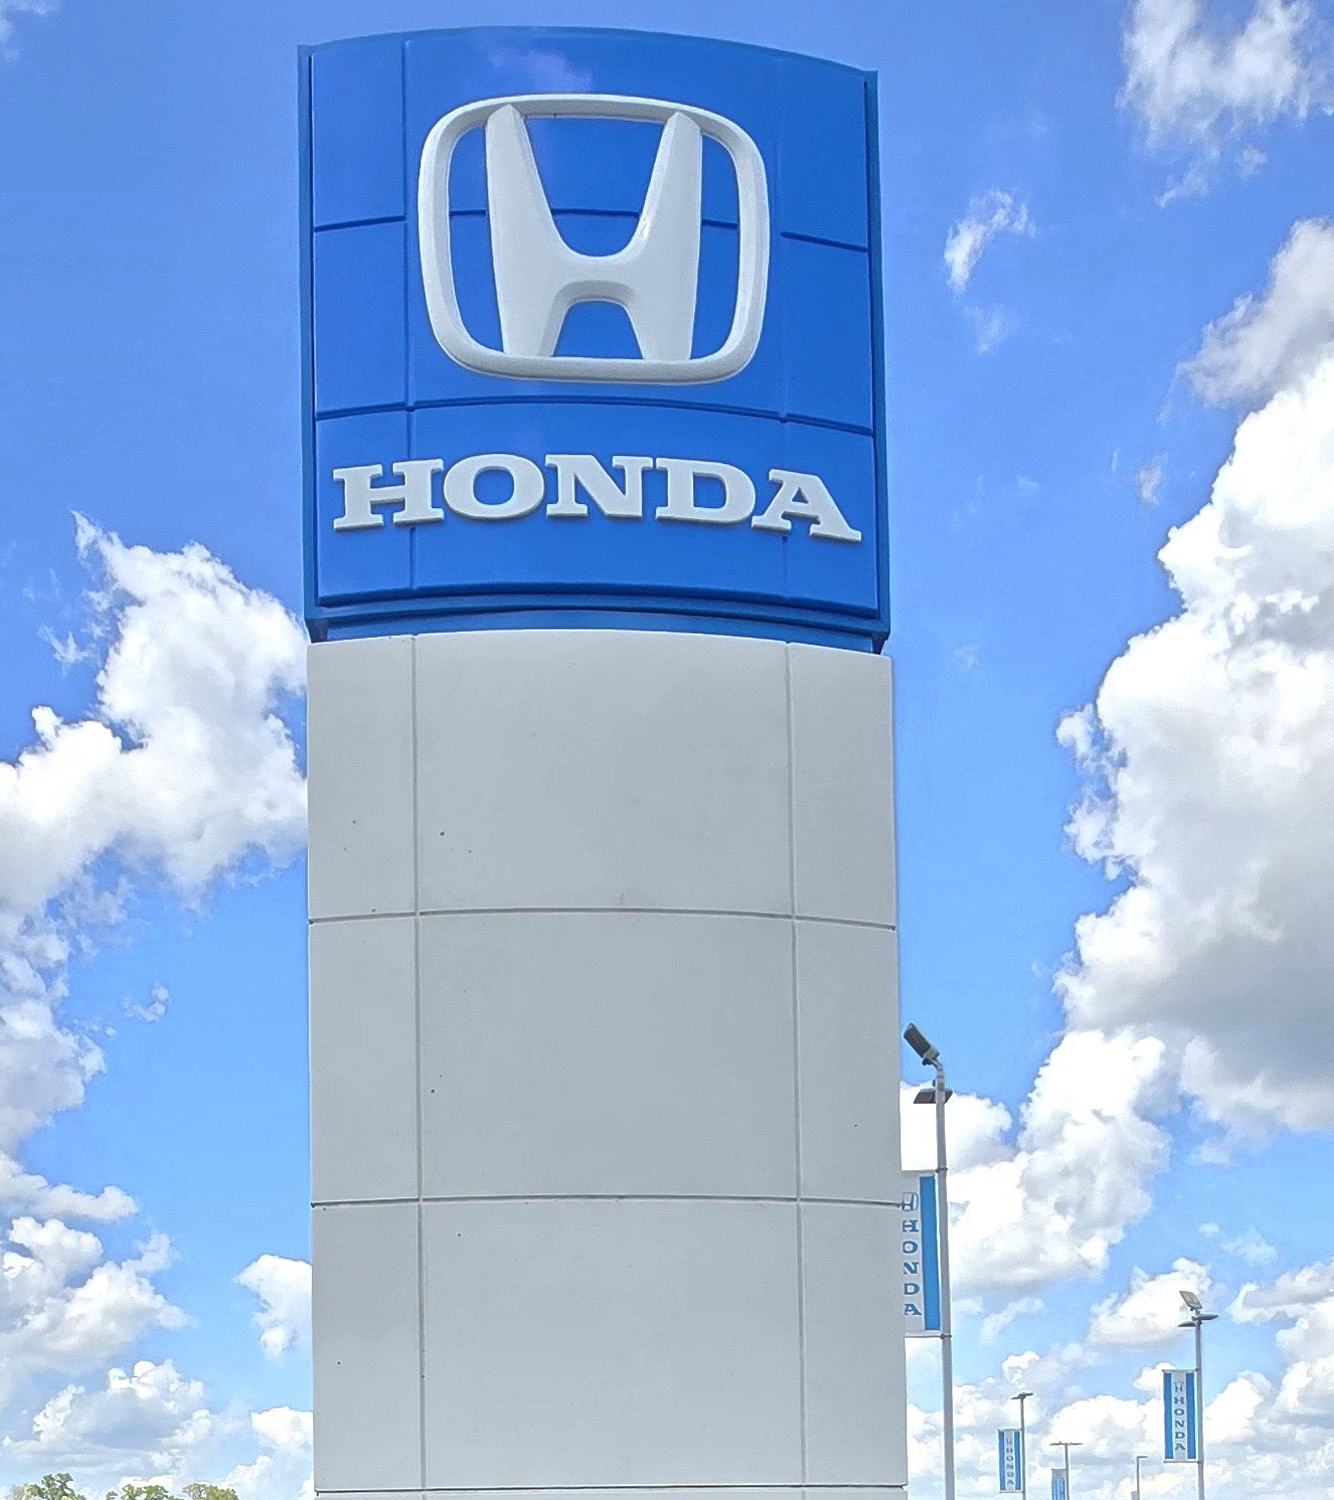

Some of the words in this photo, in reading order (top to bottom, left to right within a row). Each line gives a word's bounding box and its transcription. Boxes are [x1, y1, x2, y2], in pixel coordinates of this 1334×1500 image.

[332, 453, 862, 542] HONDA
[902, 1219, 922, 1316] HONDA
[1173, 1396, 1186, 1452] HONDA
